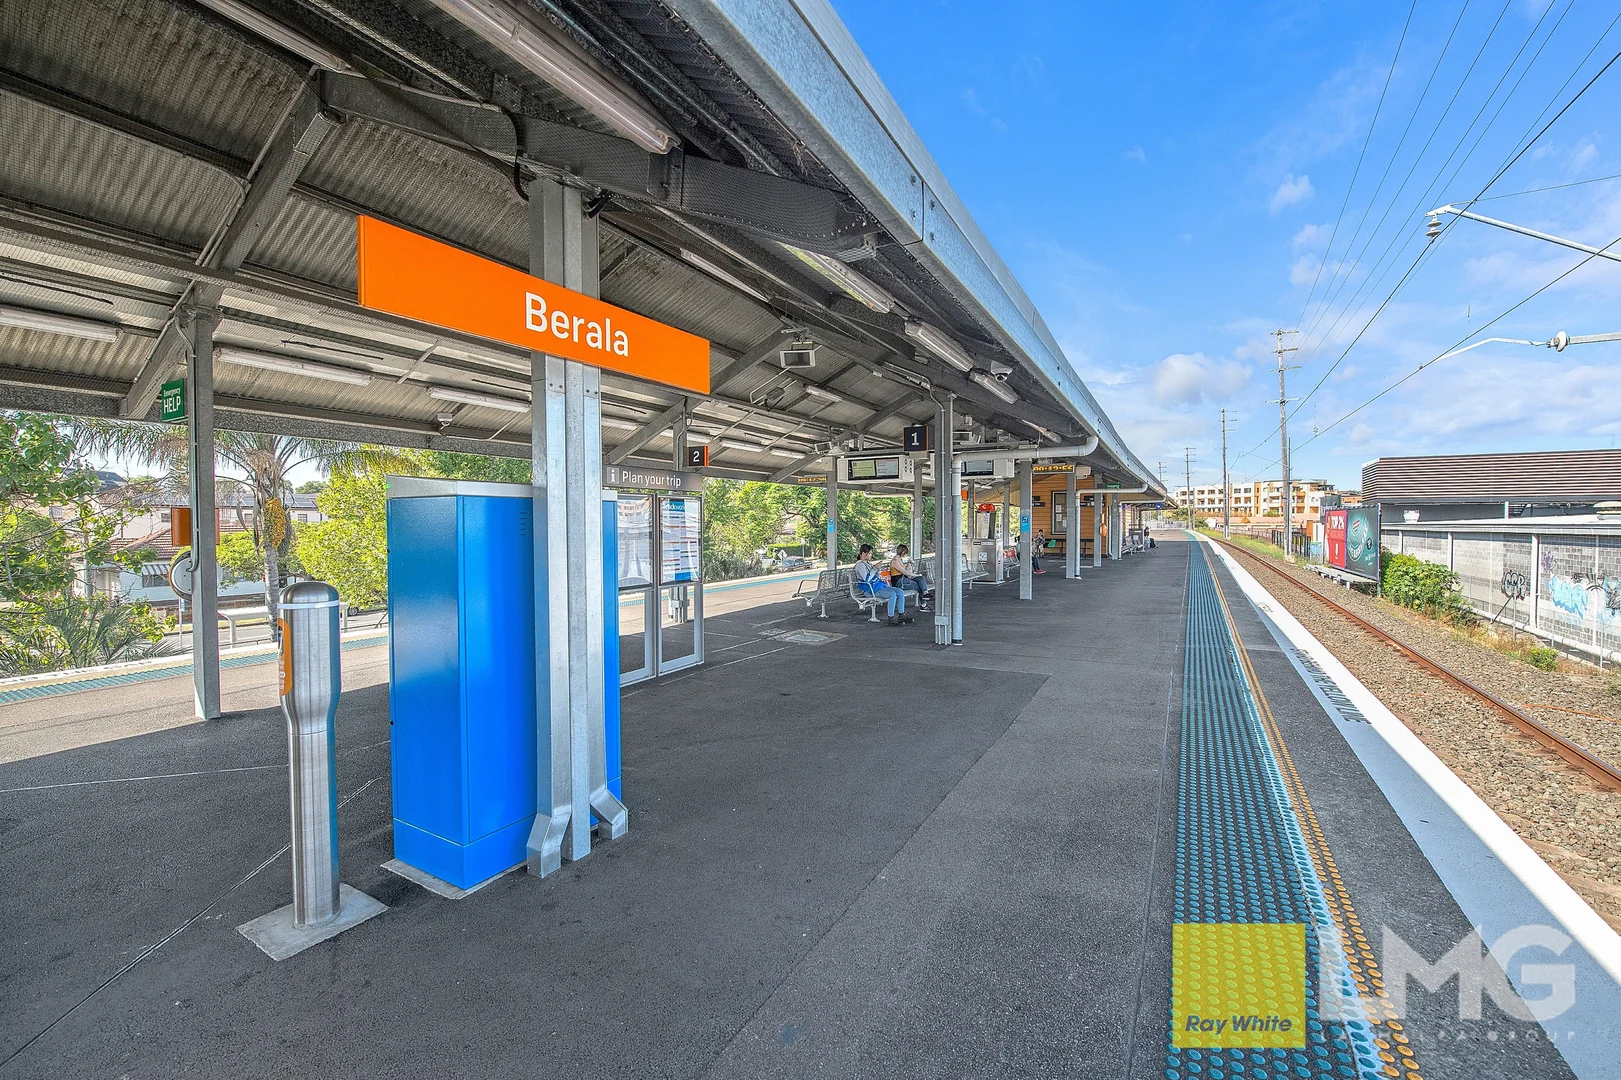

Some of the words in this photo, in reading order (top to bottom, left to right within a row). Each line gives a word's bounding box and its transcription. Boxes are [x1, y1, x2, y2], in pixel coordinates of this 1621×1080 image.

[525, 291, 629, 357] Berala
[163, 387, 181, 397] Emergency
[163, 395, 181, 414] HELP
[910, 432, 920, 446] 1
[692, 451, 700, 463] 2
[622, 470, 643, 484] Plan
[644, 475, 665, 487] your
[666, 476, 681, 489] trip
